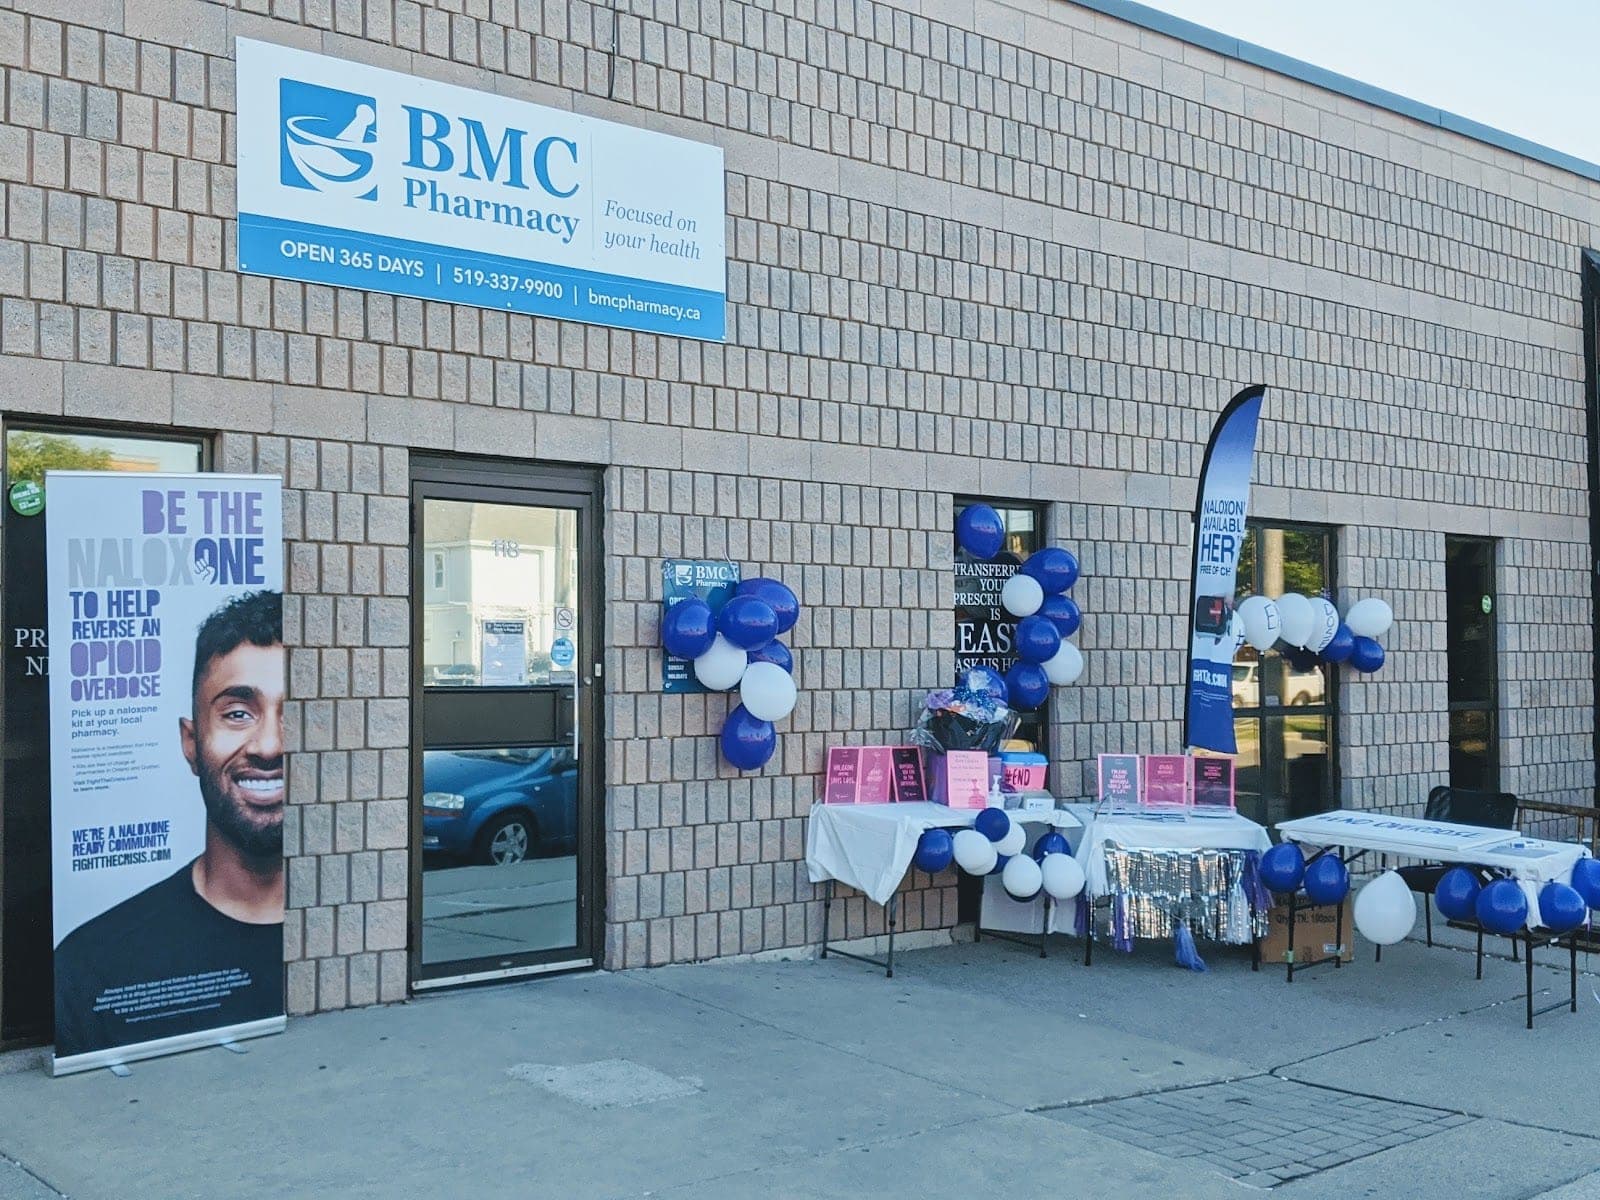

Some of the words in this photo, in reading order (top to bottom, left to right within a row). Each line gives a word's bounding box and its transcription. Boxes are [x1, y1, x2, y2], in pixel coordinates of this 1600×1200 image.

[401, 104, 580, 198] BMC
[402, 176, 580, 243] Pharmacy
[604, 200, 672, 229] Focused
[677, 217, 697, 233] on
[604, 230, 645, 250] your
[650, 234, 701, 260] health
[280, 240, 335, 265] OPEN
[340, 250, 373, 270] 365
[378, 255, 425, 278] DAYS
[453, 266, 563, 300] 519-337-9900
[588, 288, 701, 321] bmcpharmacy.ca
[142, 490, 187, 534] BE
[197, 491, 263, 534] THE
[1203, 500, 1246, 516] NALOXON
[1202, 516, 1241, 532] AVAILABL
[1200, 533, 1236, 563] HER
[68, 538, 265, 588] NALOXONE
[695, 565, 728, 580] BMC
[980, 578, 1006, 591] YOU
[69, 591, 99, 619] TO
[107, 589, 160, 618] HELP
[952, 593, 1002, 606] PRESCRI
[990, 608, 1001, 620] IS
[14, 628, 48, 647] PR
[72, 619, 135, 640] REVERSE
[141, 618, 160, 637] AN
[958, 623, 1018, 654] EAS
[70, 639, 161, 677] OPIOID
[70, 675, 161, 702] OVERDOSE
[71, 709, 91, 718] Pick
[94, 709, 106, 718] up
[117, 705, 158, 714] naloxone
[71, 719, 83, 728] kit
[85, 719, 94, 727] at
[97, 718, 117, 728] your
[120, 715, 142, 725] local
[71, 728, 119, 740] pharmacy.
[1005, 768, 1031, 786] #END
[108, 826, 115, 839] A
[119, 820, 170, 838] NALOXONE
[72, 841, 105, 857] READY
[108, 834, 168, 852] COMMUNITY
[72, 848, 171, 872] FIGHTTHECRISIS.COM
